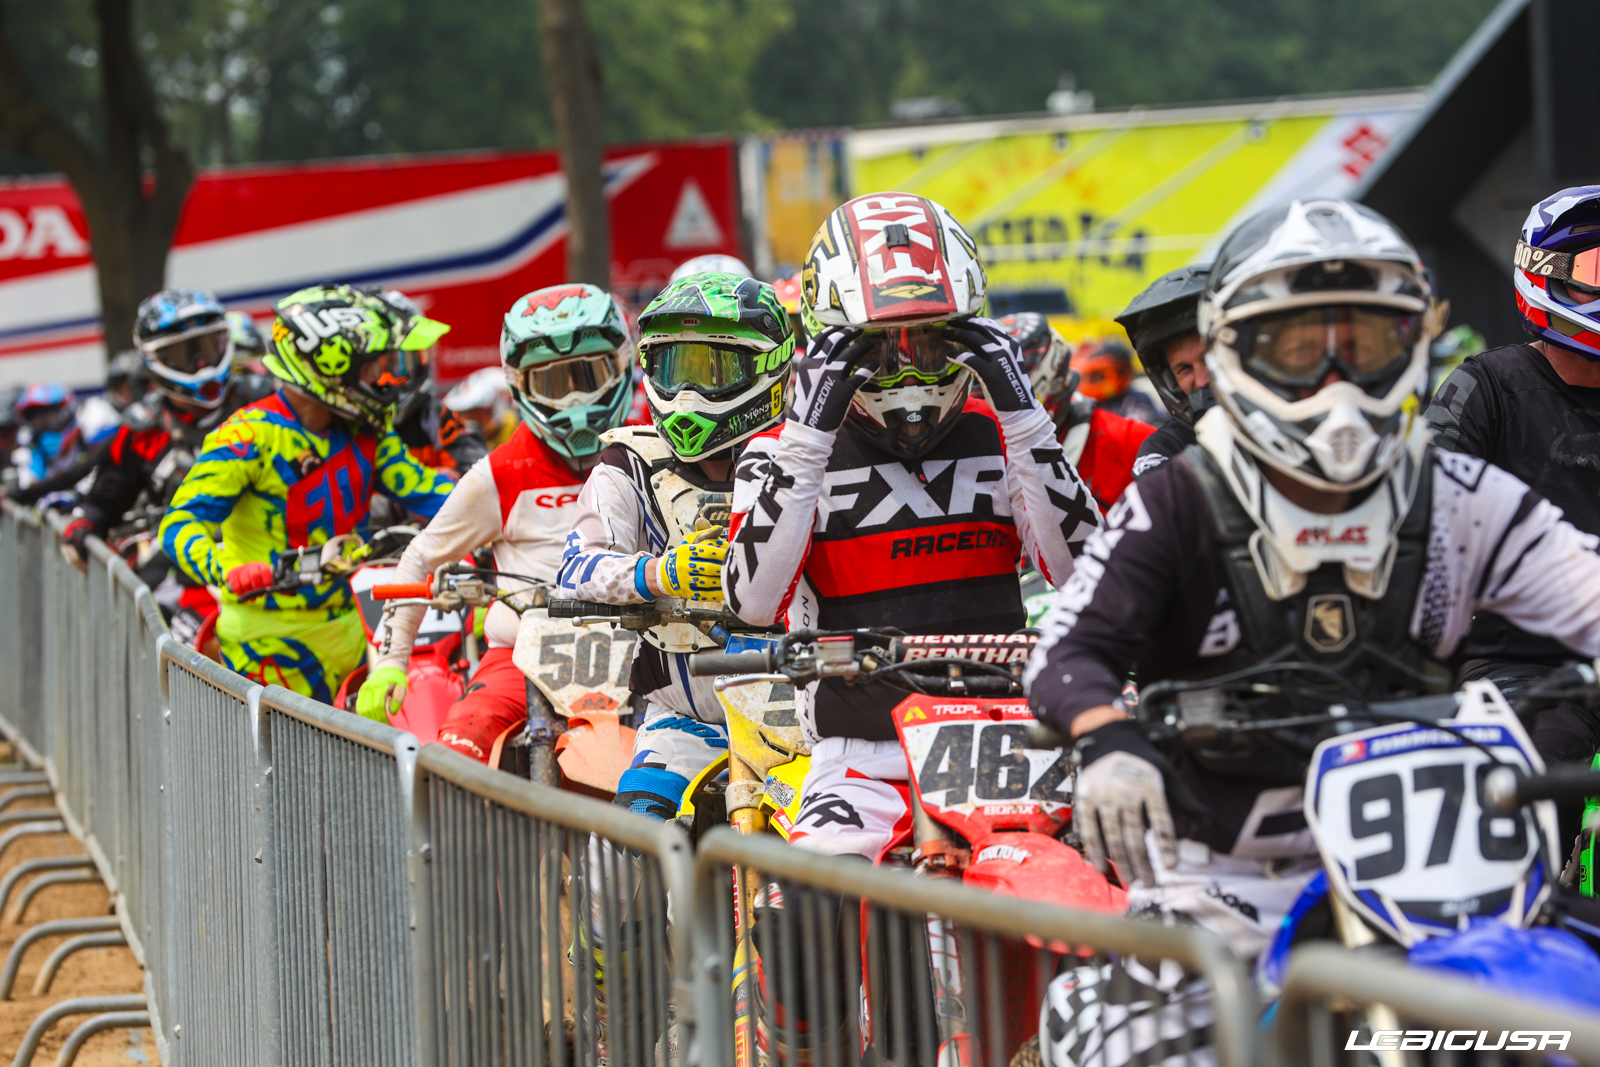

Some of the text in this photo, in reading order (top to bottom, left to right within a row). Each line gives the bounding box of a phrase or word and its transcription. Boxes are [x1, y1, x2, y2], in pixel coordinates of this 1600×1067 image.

[1514, 243, 1556, 276] 00%
[773, 389, 780, 409] 5
[816, 455, 1011, 533] FXR
[538, 629, 639, 691] 507
[902, 646, 1030, 664] RENTHA
[918, 724, 1074, 804] 462
[1348, 763, 1528, 882] 978
